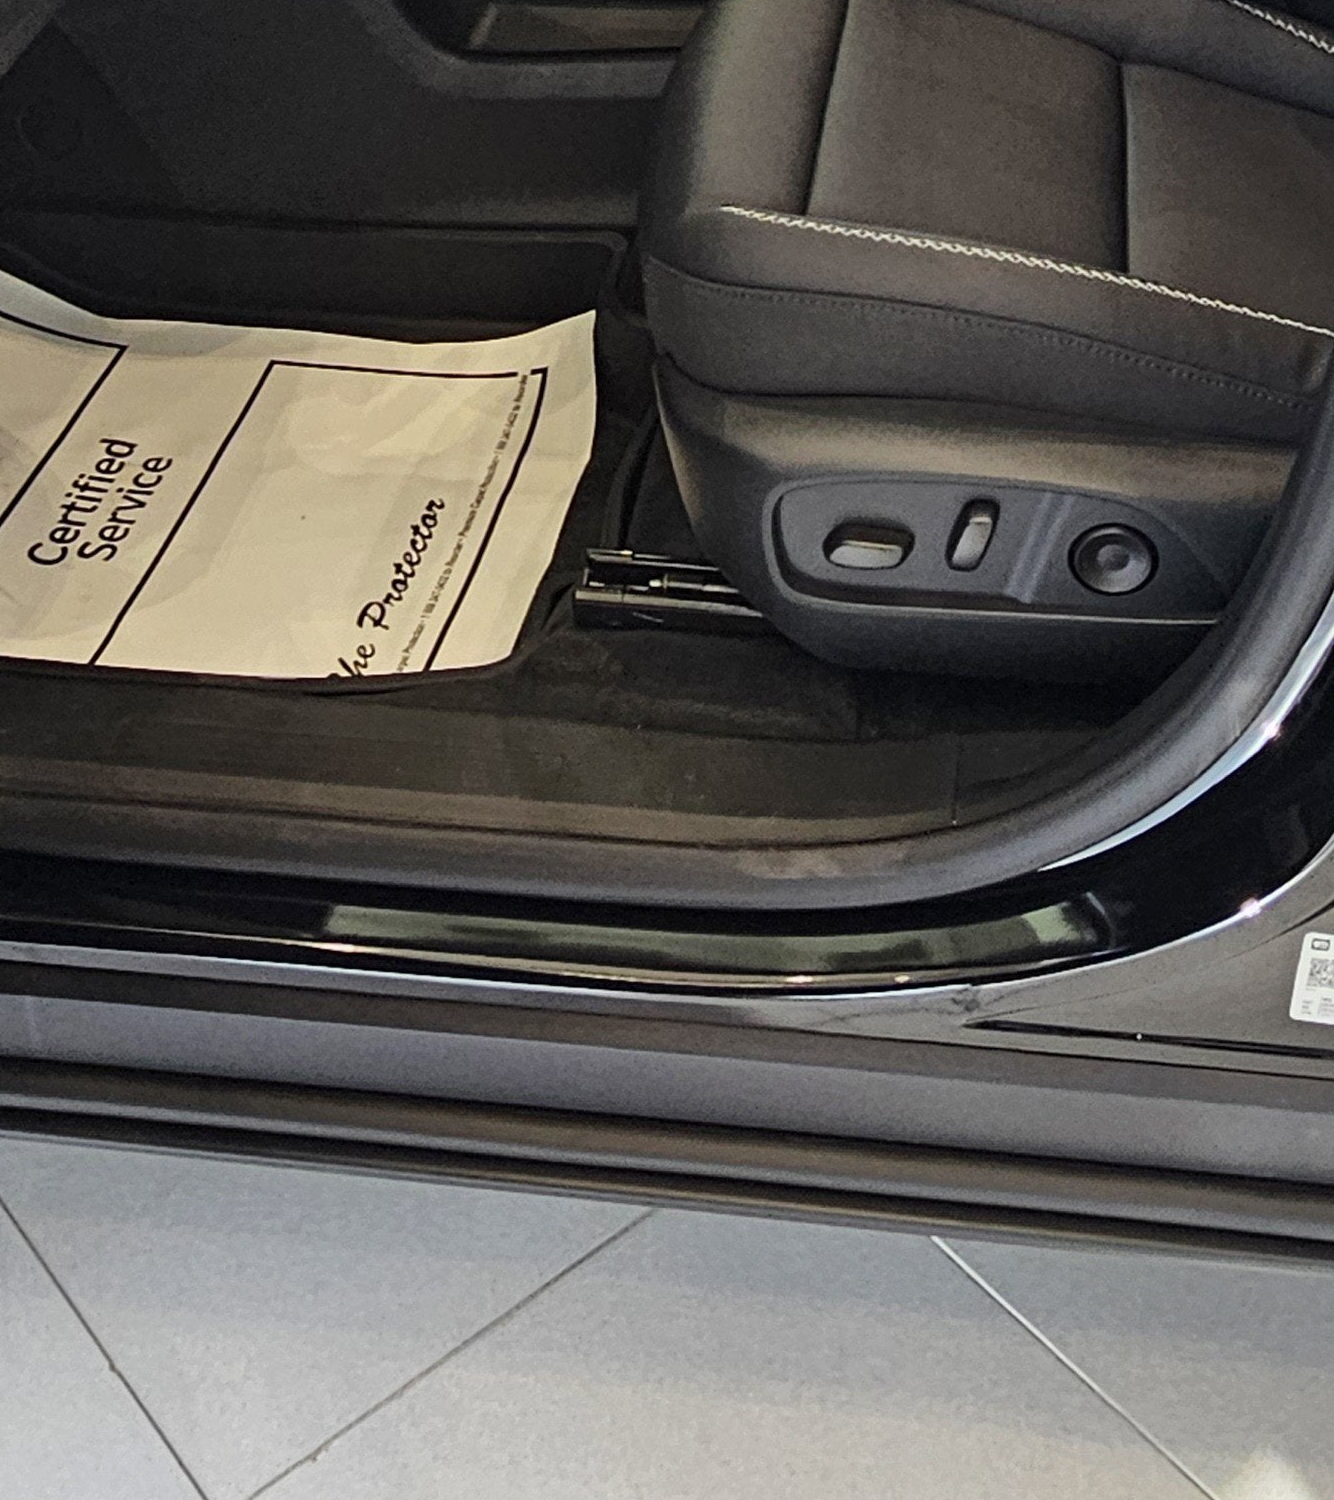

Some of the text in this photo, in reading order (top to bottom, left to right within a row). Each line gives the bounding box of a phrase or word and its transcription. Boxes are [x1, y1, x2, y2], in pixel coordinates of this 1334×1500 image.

[27, 437, 139, 566] Certified
[76, 456, 174, 562] Service
[332, 643, 376, 677] he
[356, 498, 446, 631] Protector
